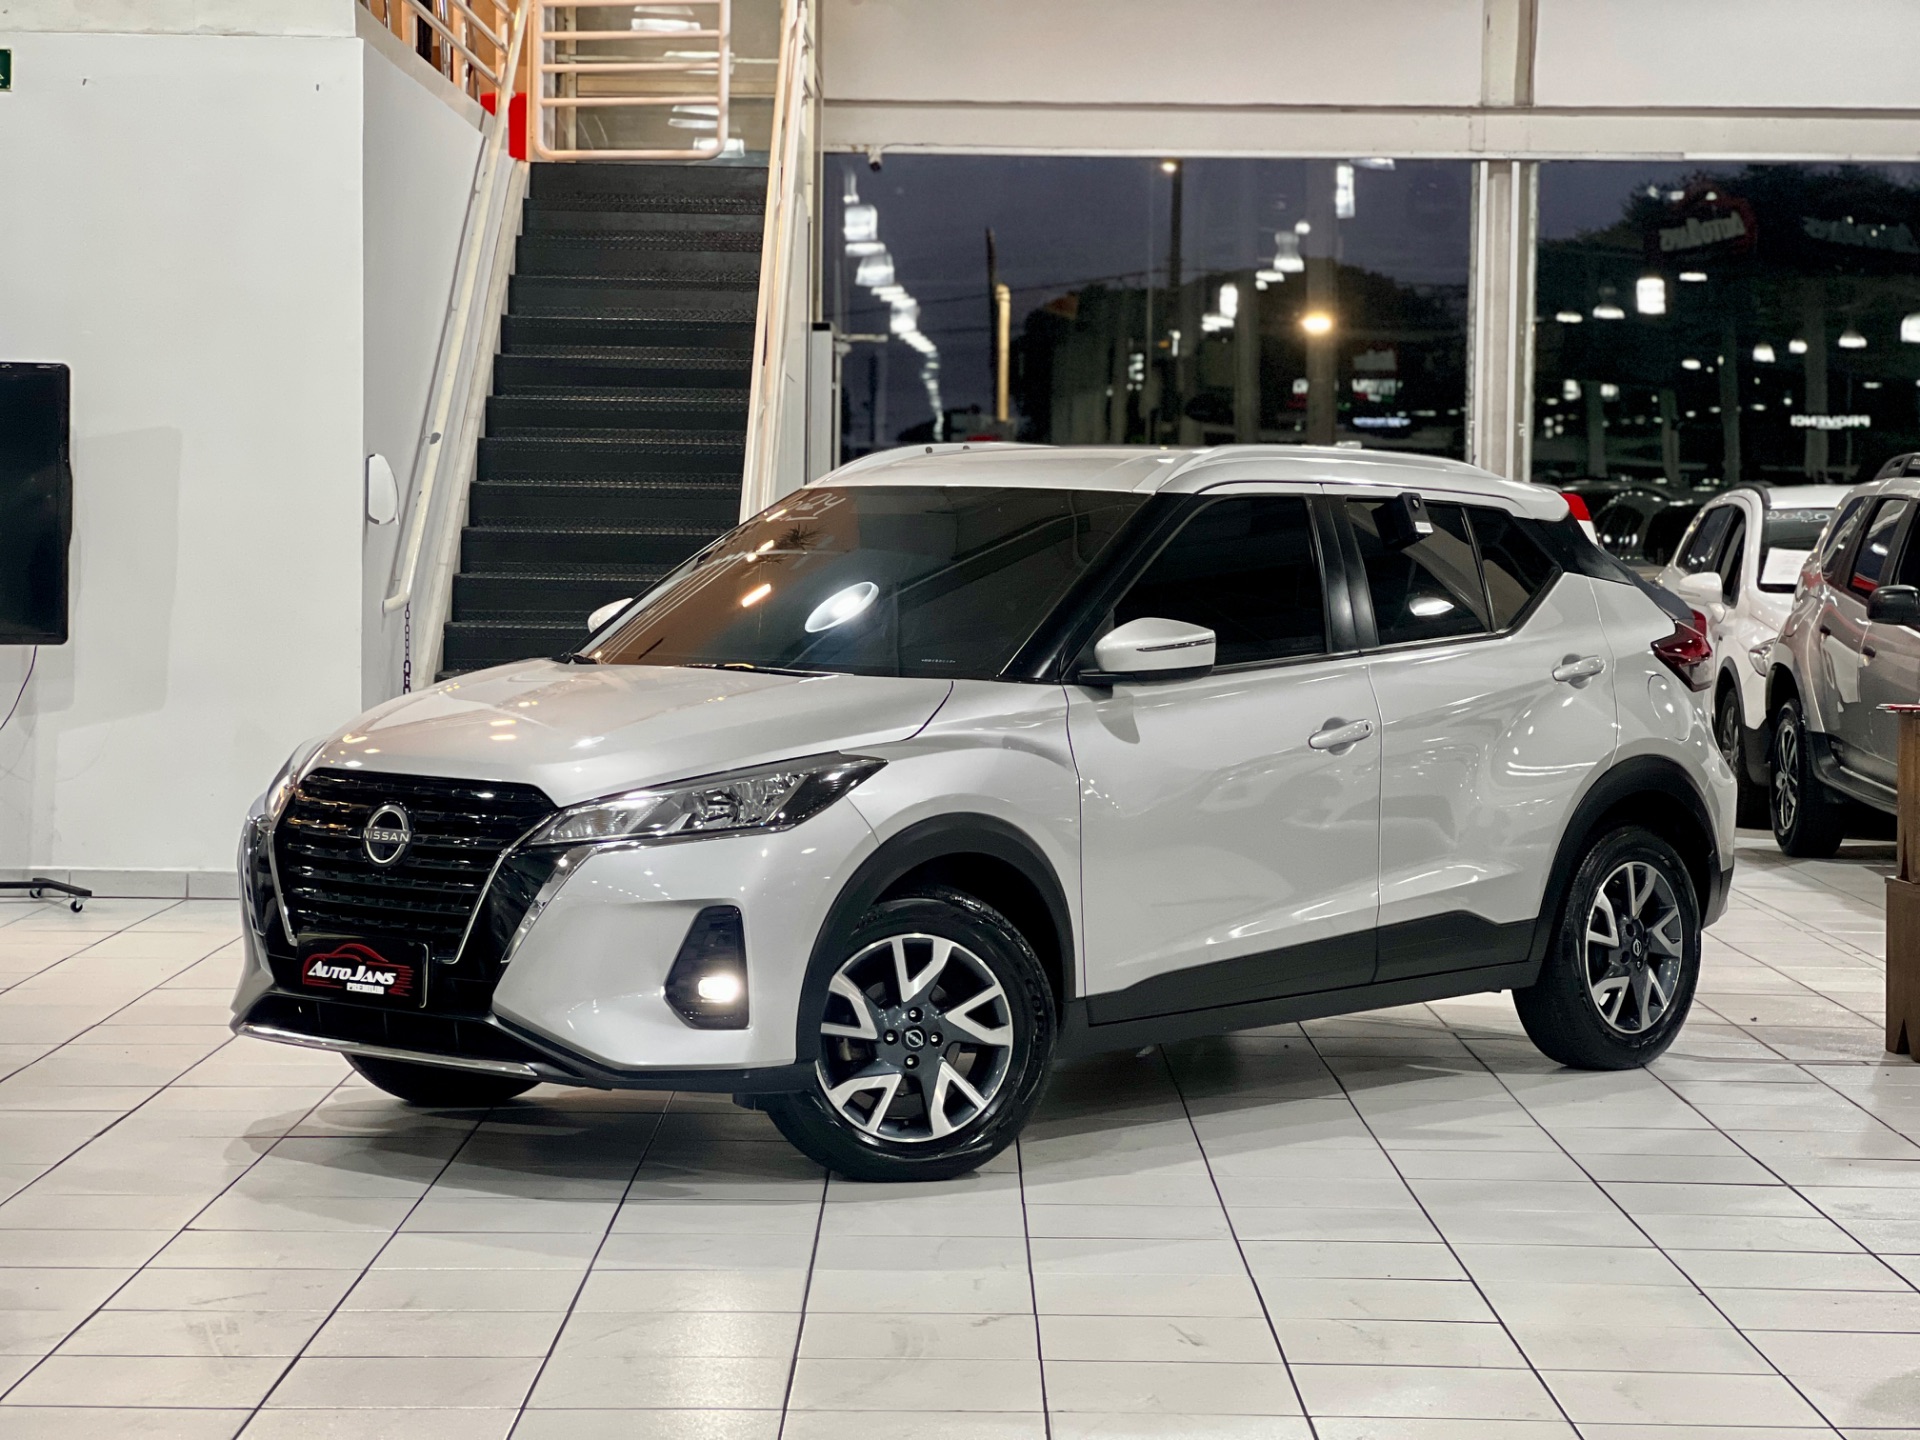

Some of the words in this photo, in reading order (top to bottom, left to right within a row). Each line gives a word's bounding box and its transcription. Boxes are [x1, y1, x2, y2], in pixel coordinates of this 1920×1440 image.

[363, 829, 410, 842] NISSAN
[307, 960, 351, 980] AUTO
[349, 965, 397, 985] JANS
